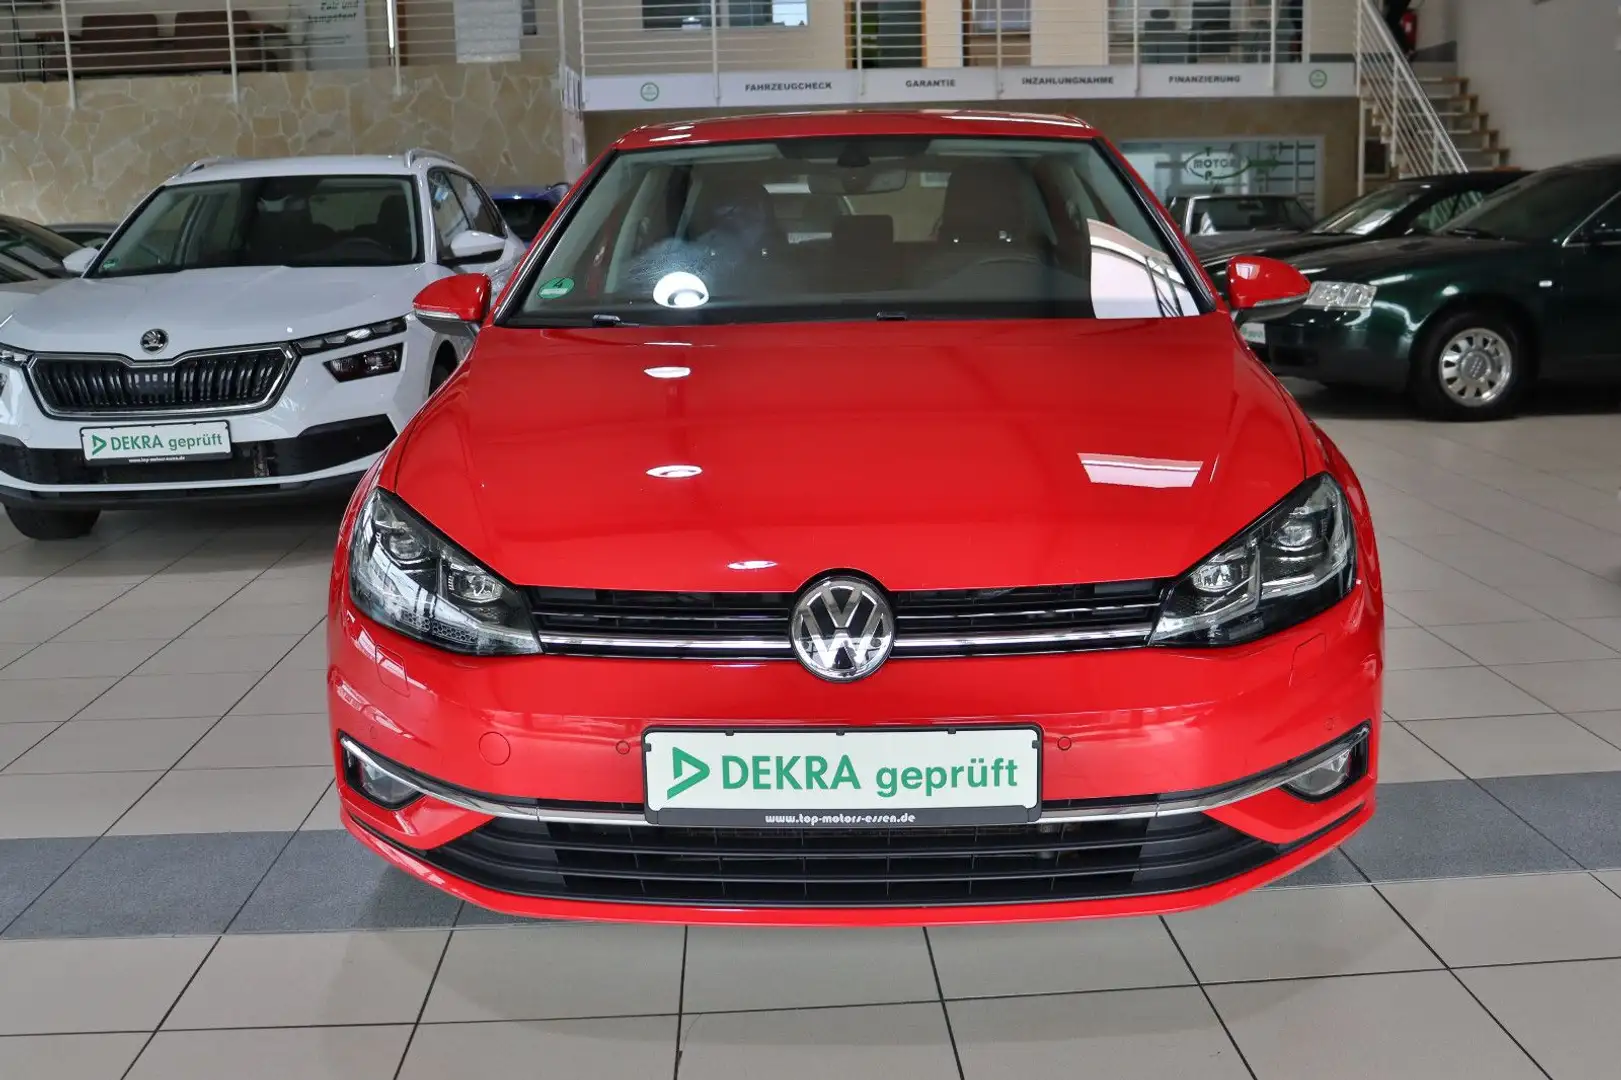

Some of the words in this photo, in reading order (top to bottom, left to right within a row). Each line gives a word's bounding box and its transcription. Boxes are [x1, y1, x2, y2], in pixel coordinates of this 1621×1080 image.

[905, 79, 956, 87] GARANTIE
[1022, 76, 1114, 85] INZAHLUNGNAHME
[1168, 75, 1241, 84] FINANZIERUNG
[745, 82, 832, 91] FAHRZEUGCHECK
[110, 434, 164, 451] DEKRA
[168, 433, 223, 451] geprüft
[721, 754, 861, 790] DEKRA
[875, 757, 1018, 798] geprüft
[764, 812, 916, 826] www.top-motors-essen.de
